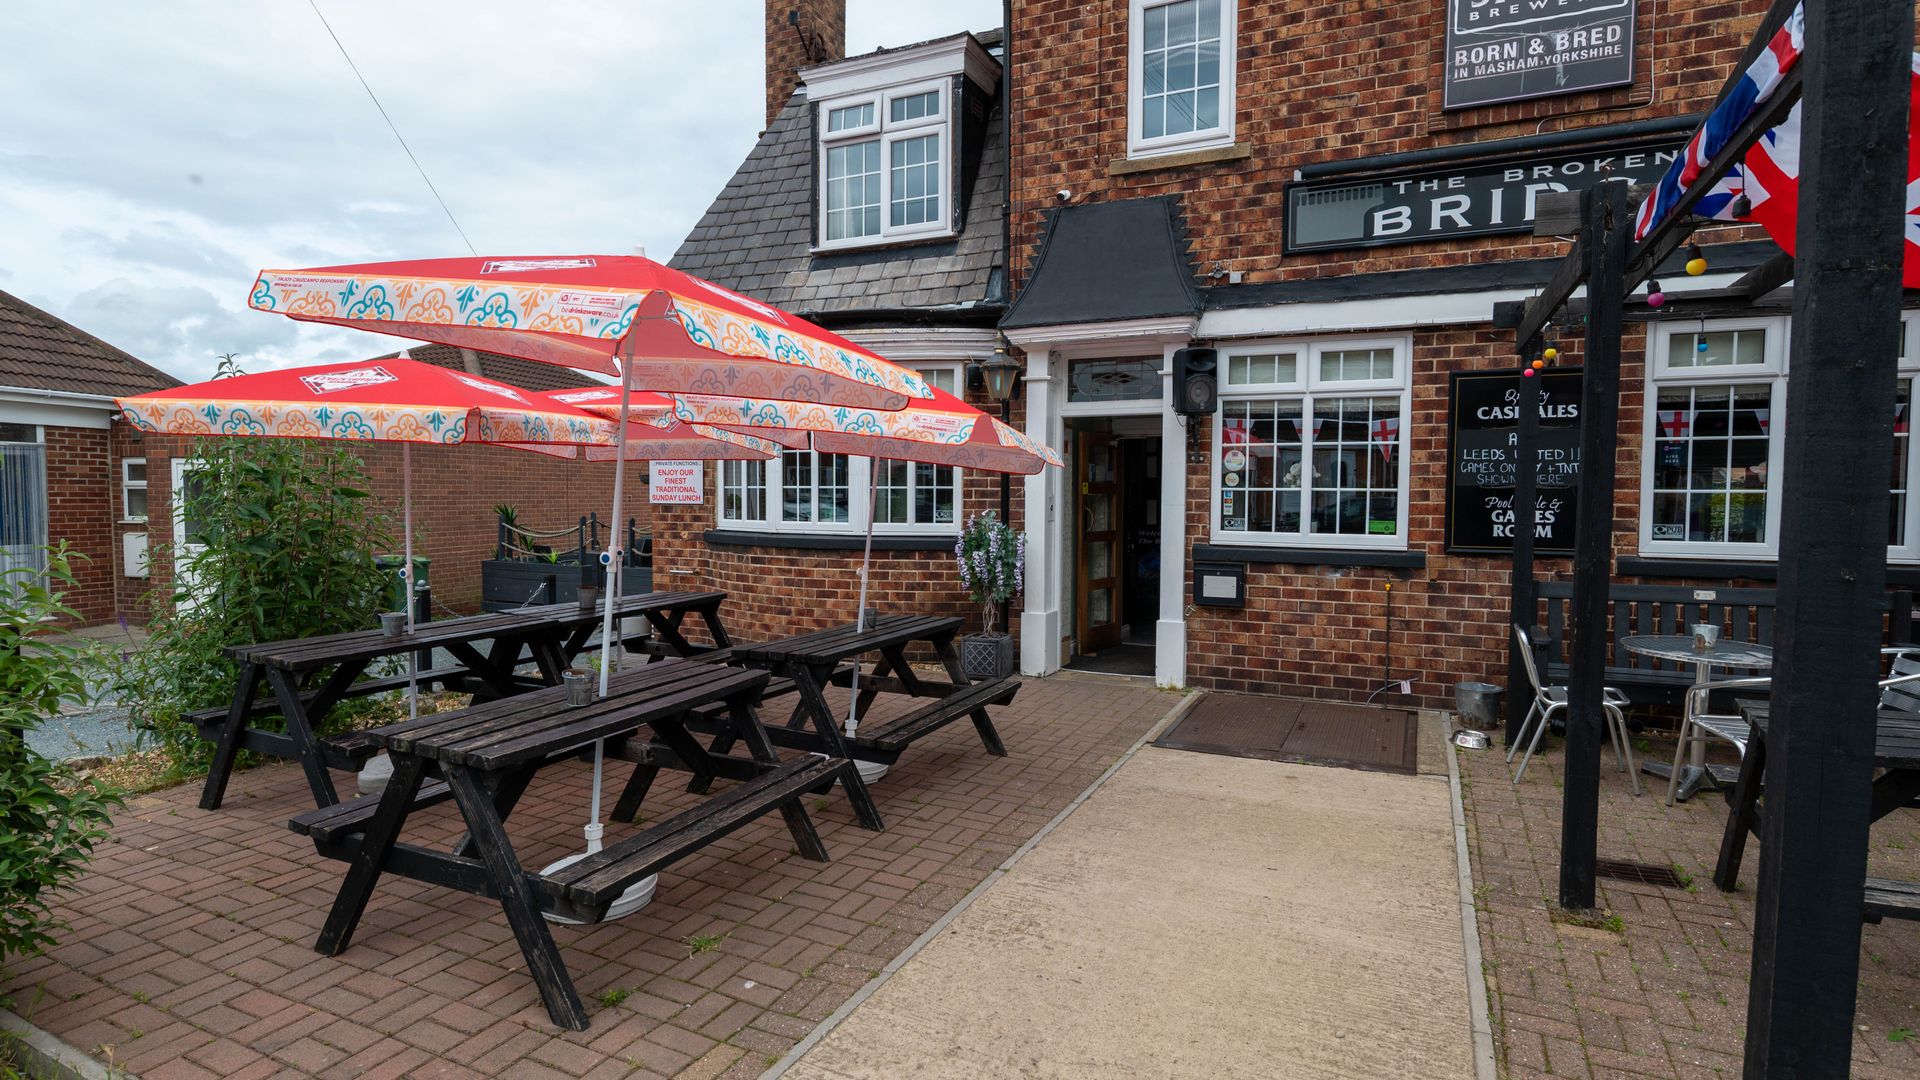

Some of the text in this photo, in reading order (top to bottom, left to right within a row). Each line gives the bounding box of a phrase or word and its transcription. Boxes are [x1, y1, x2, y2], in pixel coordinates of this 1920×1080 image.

[1454, 25, 1622, 66] BORN & BRED
[1454, 68, 1468, 79] IN
[1392, 149, 1678, 195] THE BROKEN
[1373, 177, 1636, 237] BRID
[1463, 449, 1505, 460] LEEDS
[1460, 462, 1495, 473] GAMES
[1485, 495, 1514, 508] Pool
[1491, 510, 1556, 523] GAES
[1492, 524, 1553, 538] ROM
